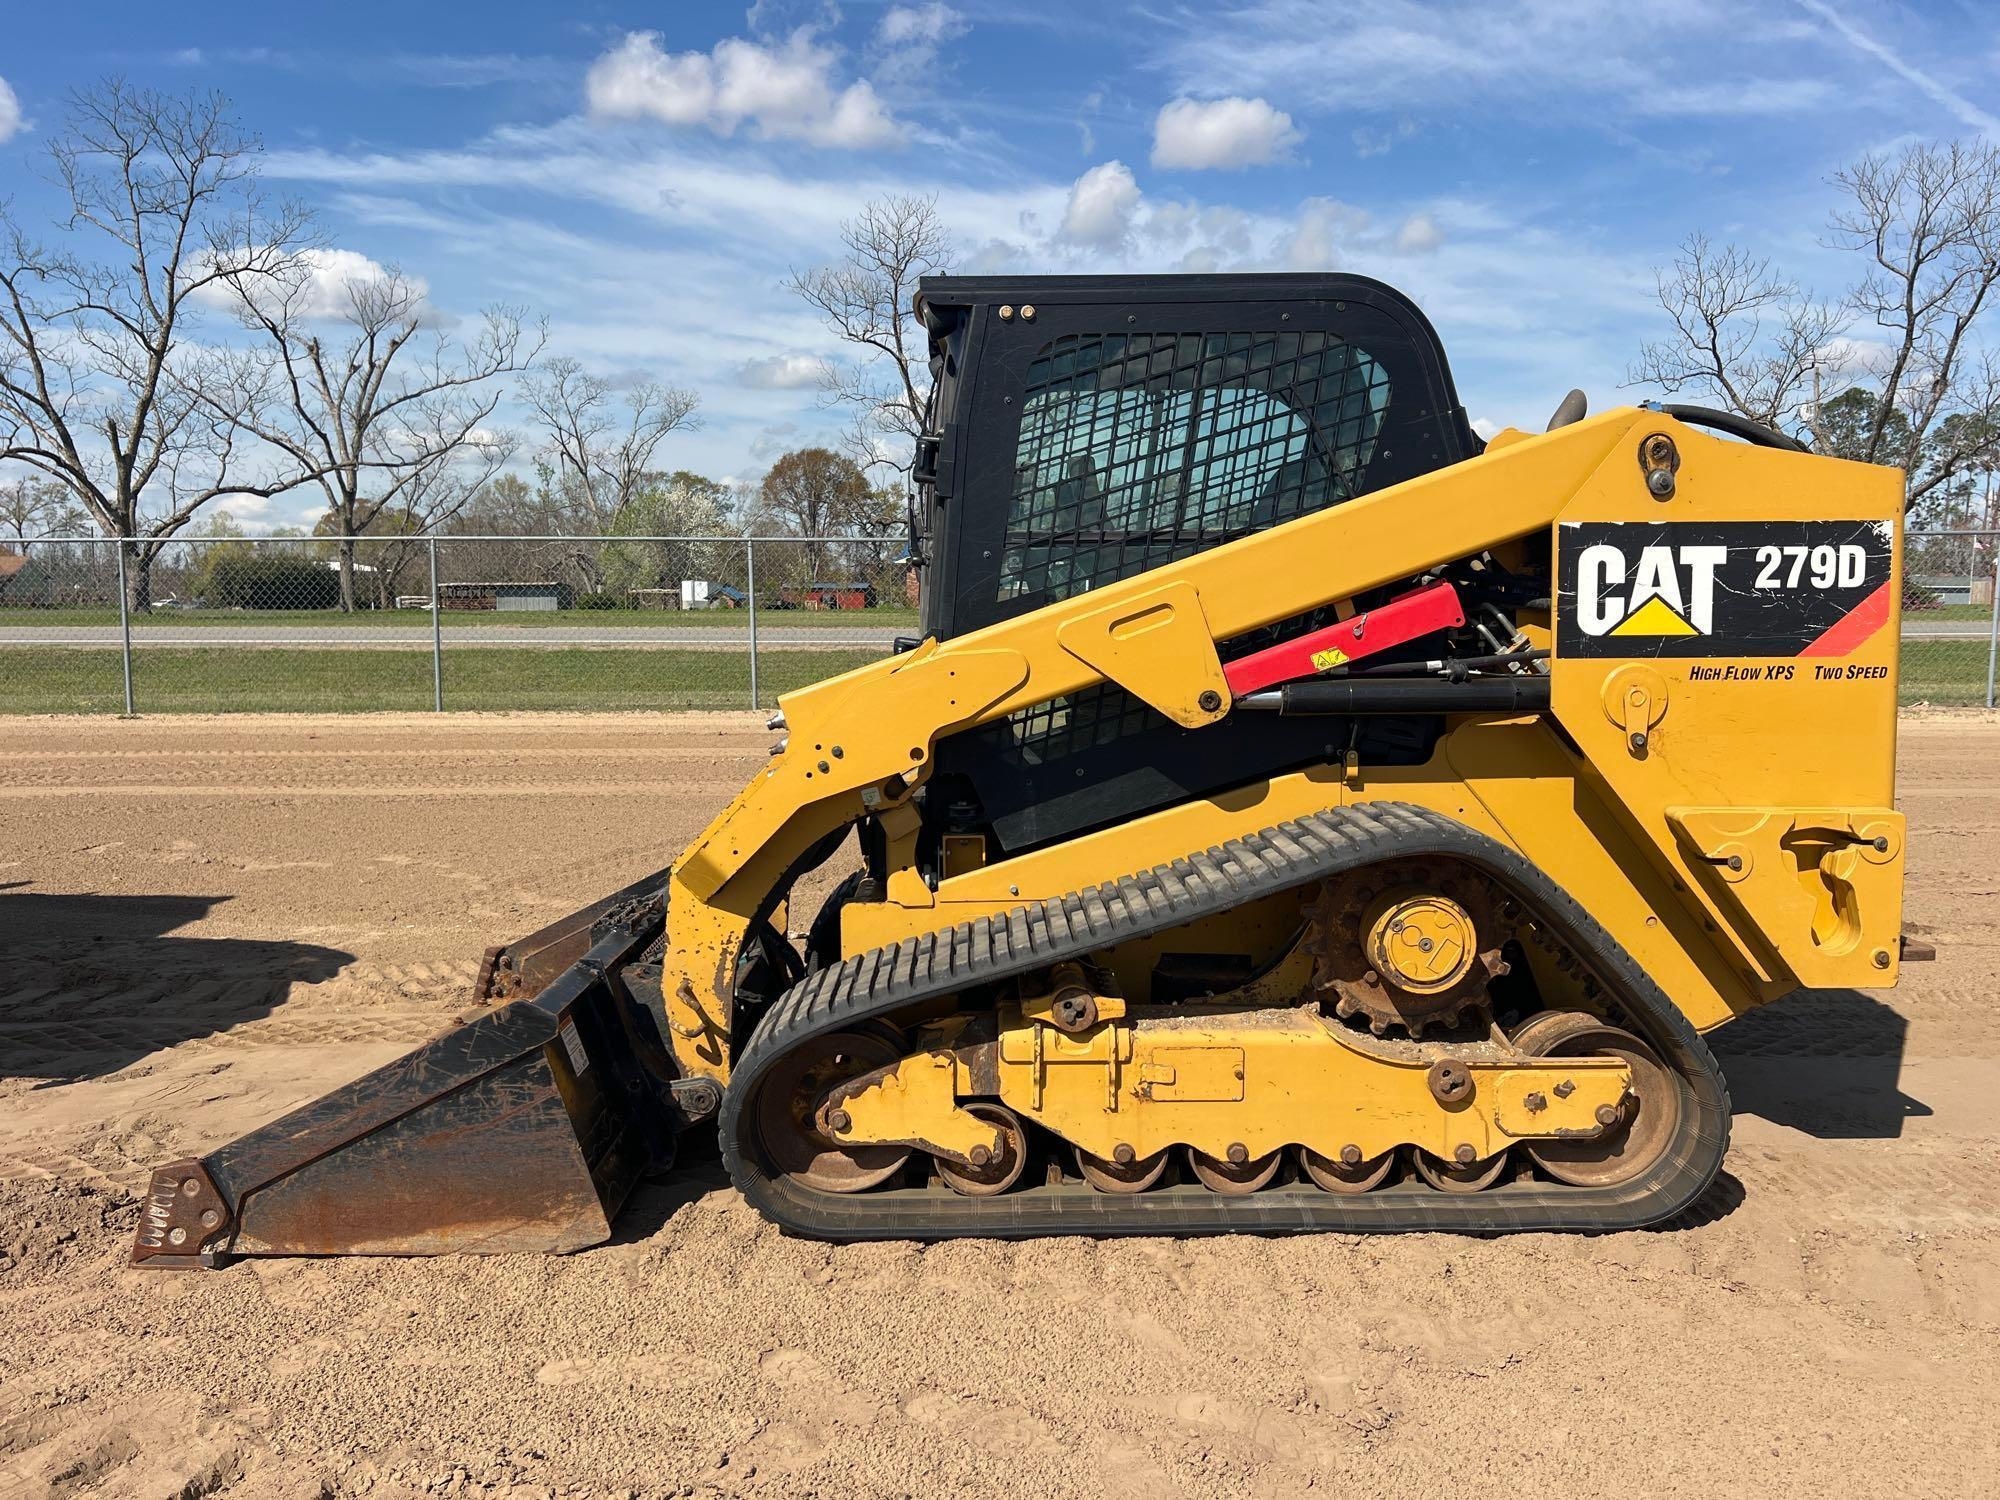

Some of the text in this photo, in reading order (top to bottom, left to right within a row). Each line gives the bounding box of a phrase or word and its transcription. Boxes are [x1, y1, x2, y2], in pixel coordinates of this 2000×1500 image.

[1577, 544, 1728, 636] CAT
[1754, 545, 1867, 590] 279D
[1764, 665, 1795, 680] XPS
